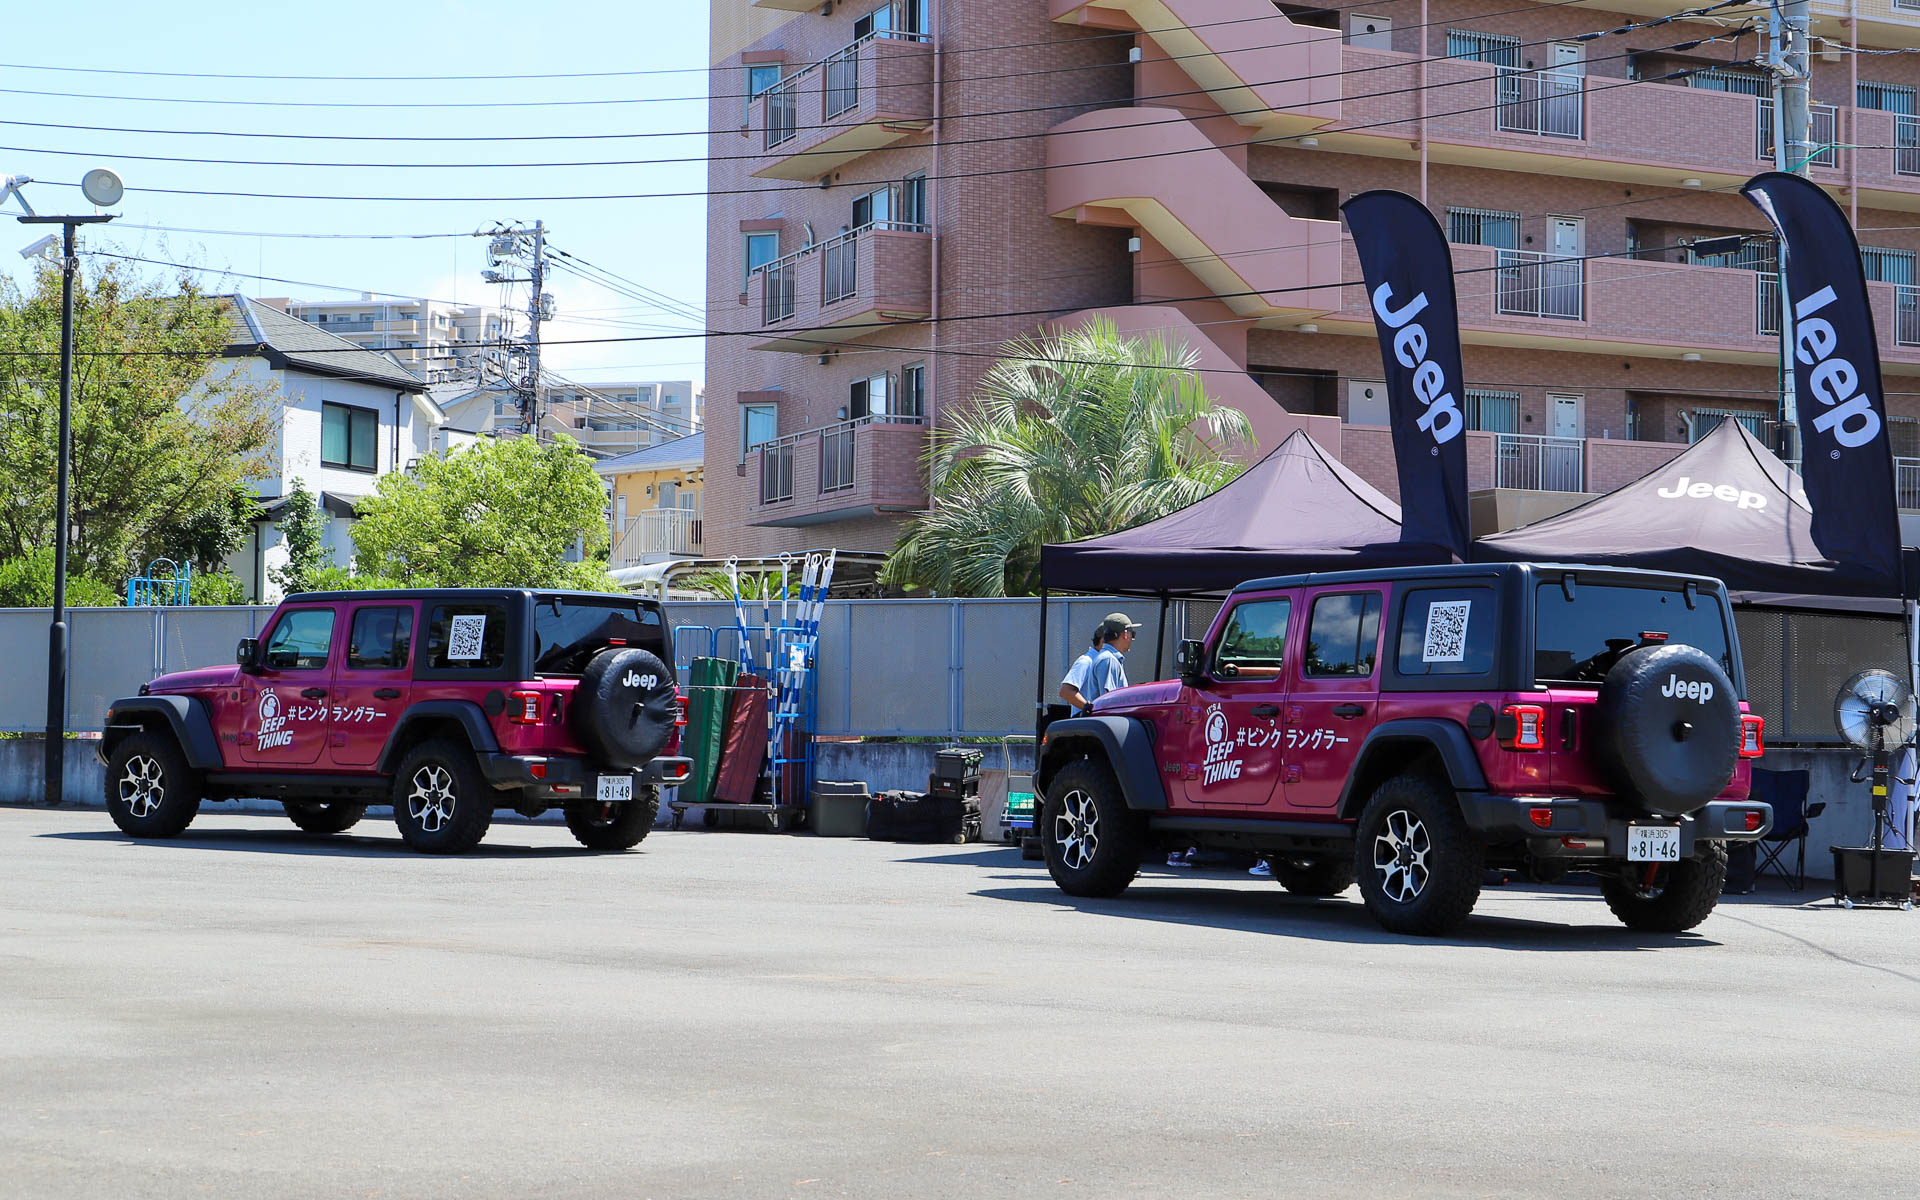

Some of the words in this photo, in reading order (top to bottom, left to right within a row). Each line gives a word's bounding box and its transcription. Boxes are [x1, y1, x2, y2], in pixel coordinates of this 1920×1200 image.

[1373, 281, 1463, 444] Jeep
[1658, 477, 1767, 509] Jeep
[623, 670, 657, 690] Jeep
[1661, 674, 1713, 704] Jeep
[1206, 703, 1217, 716] IT'S
[1216, 702, 1222, 710] A
[257, 716, 286, 736] JEEP
[257, 730, 294, 752] THING
[1203, 741, 1234, 765] JEEP
[1162, 760, 1181, 774] Jeep
[1203, 759, 1243, 786] THING
[1639, 841, 1677, 858] 81-46
